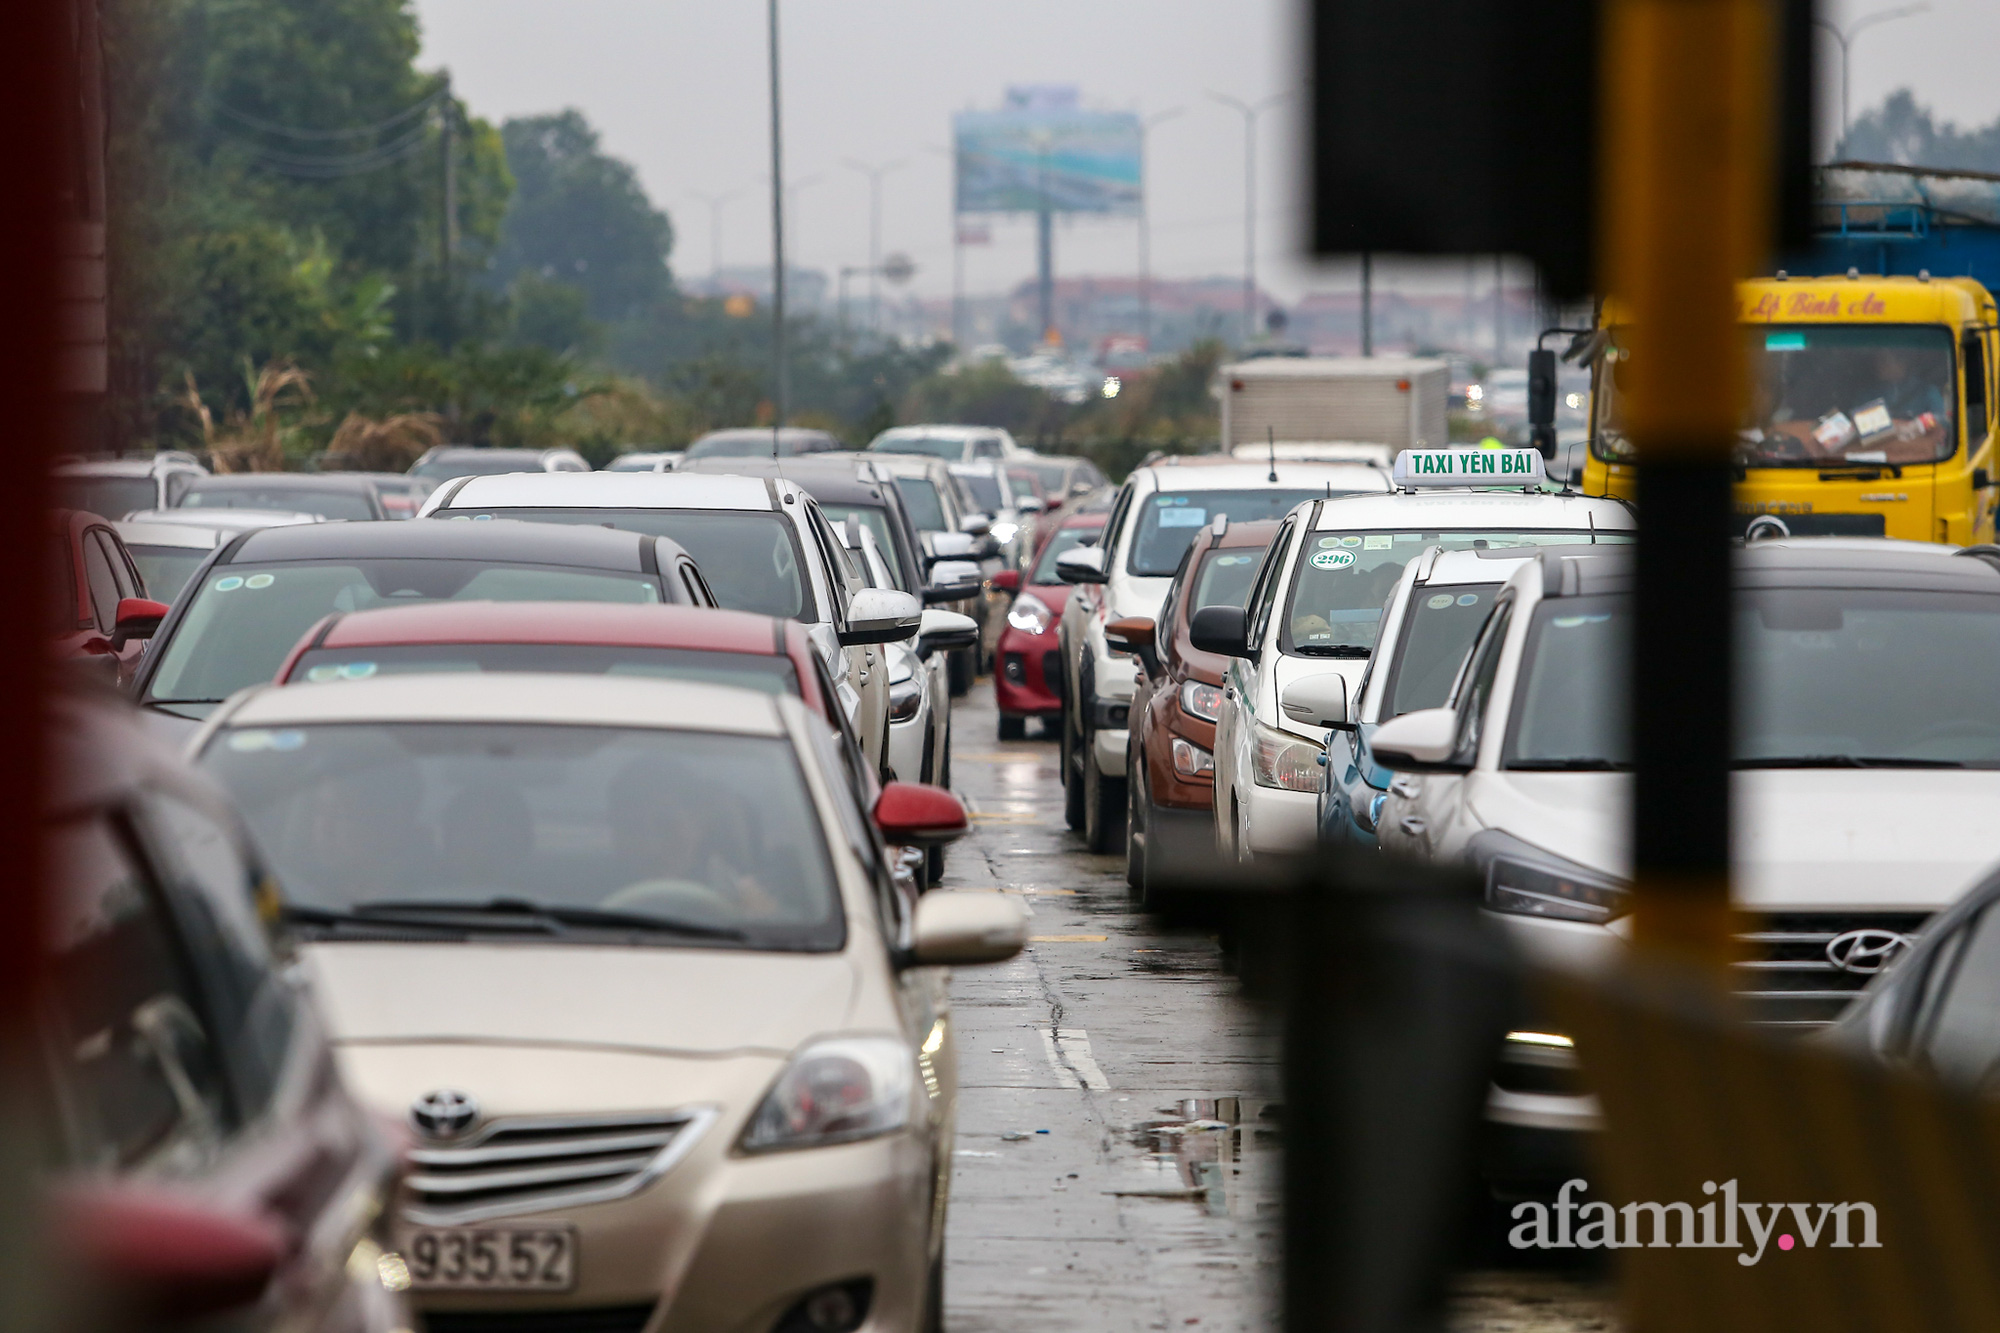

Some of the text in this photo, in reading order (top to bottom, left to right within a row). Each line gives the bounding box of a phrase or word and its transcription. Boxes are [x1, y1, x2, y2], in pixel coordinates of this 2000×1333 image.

[1412, 450, 1532, 474] TAXI YÊN BÁI
[1316, 554, 1350, 565] 296
